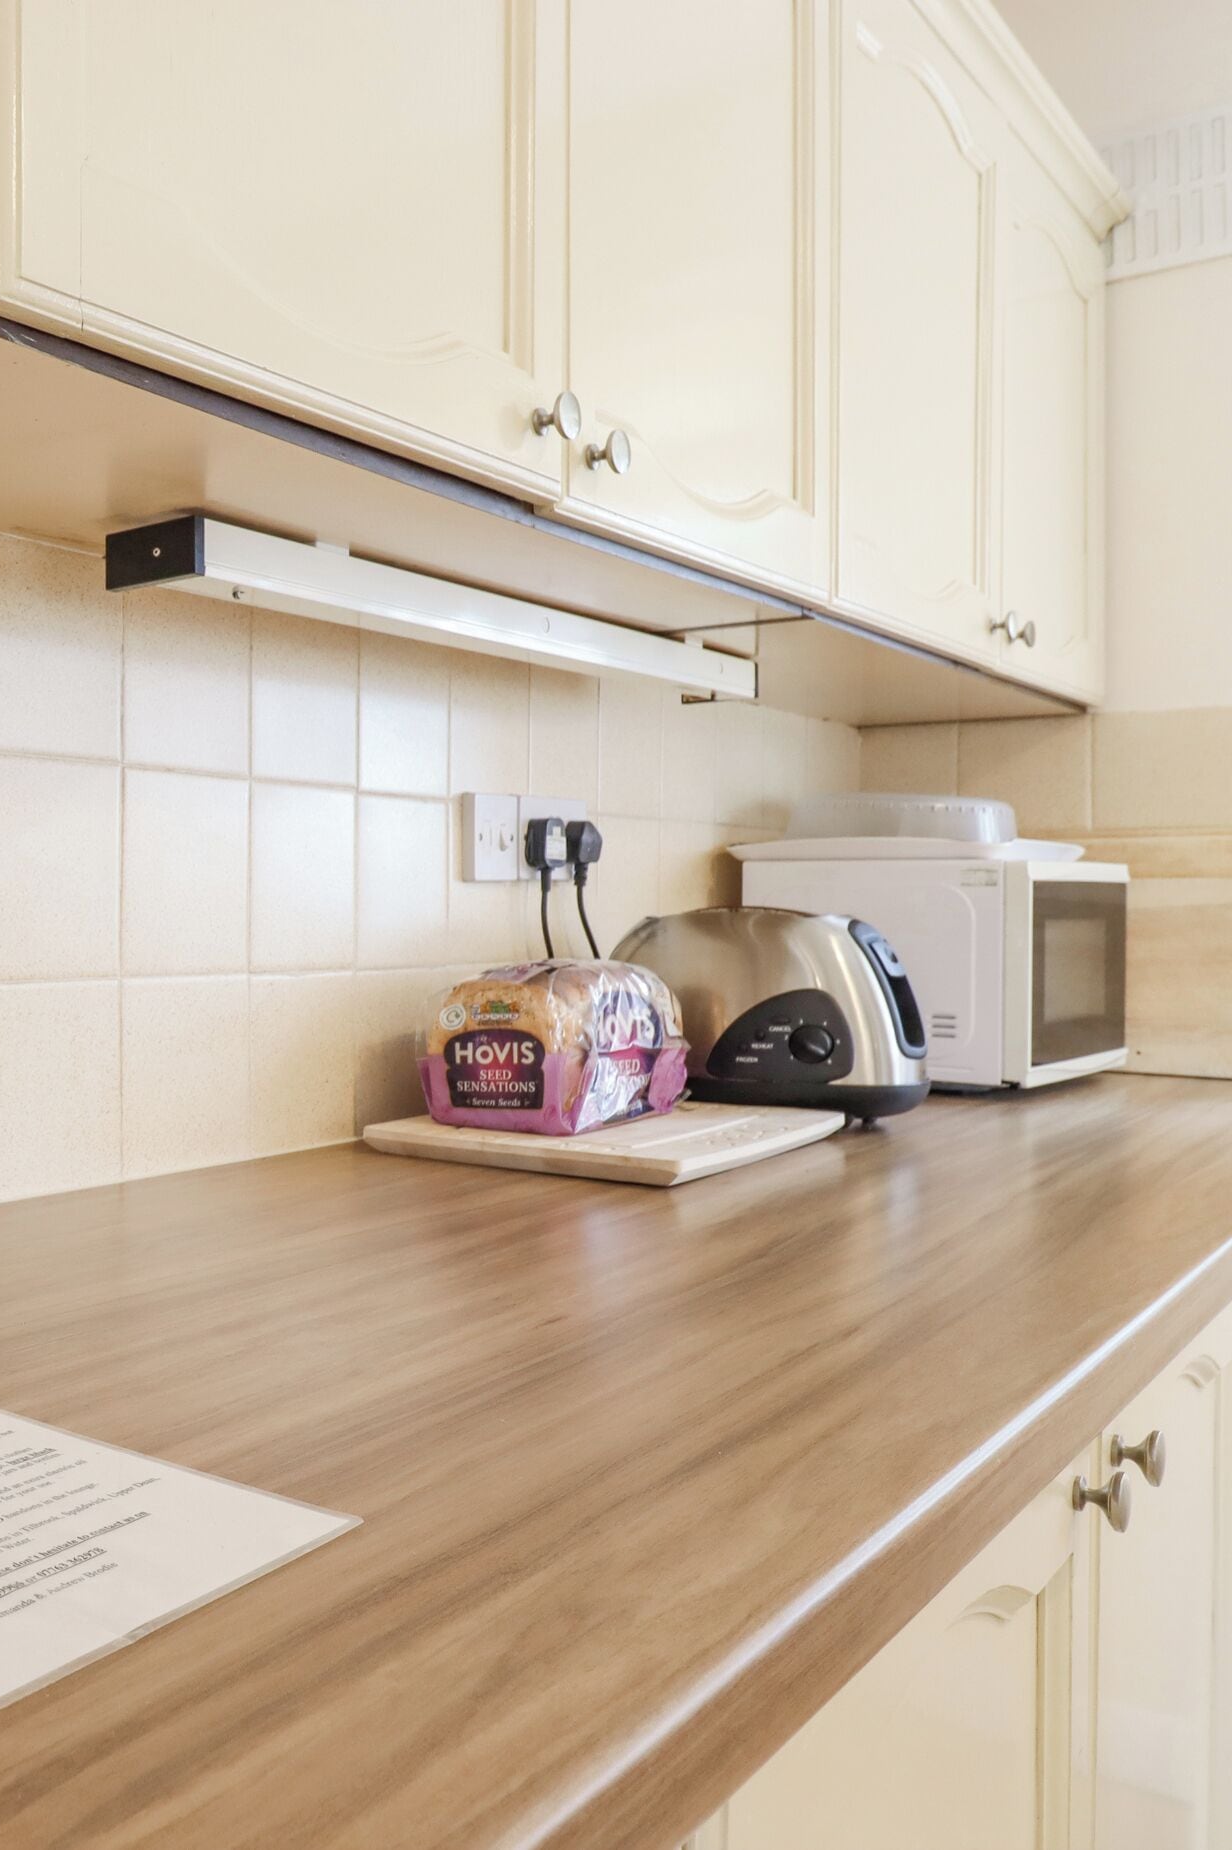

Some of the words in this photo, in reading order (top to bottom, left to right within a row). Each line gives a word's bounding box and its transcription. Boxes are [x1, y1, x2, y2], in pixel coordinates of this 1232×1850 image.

[479, 1069, 512, 1081] SEED
[456, 1080, 537, 1094] SENSATIONS
[471, 1098, 497, 1107] Seven
[498, 1098, 521, 1107] Seeds
[13, 1555, 45, 1569] don't
[39, 1540, 83, 1558] hesitate
[91, 1521, 128, 1536] contact
[135, 1511, 150, 1519] on
[50, 1578, 85, 1593] Andrew
[84, 1563, 118, 1577] Brodie
